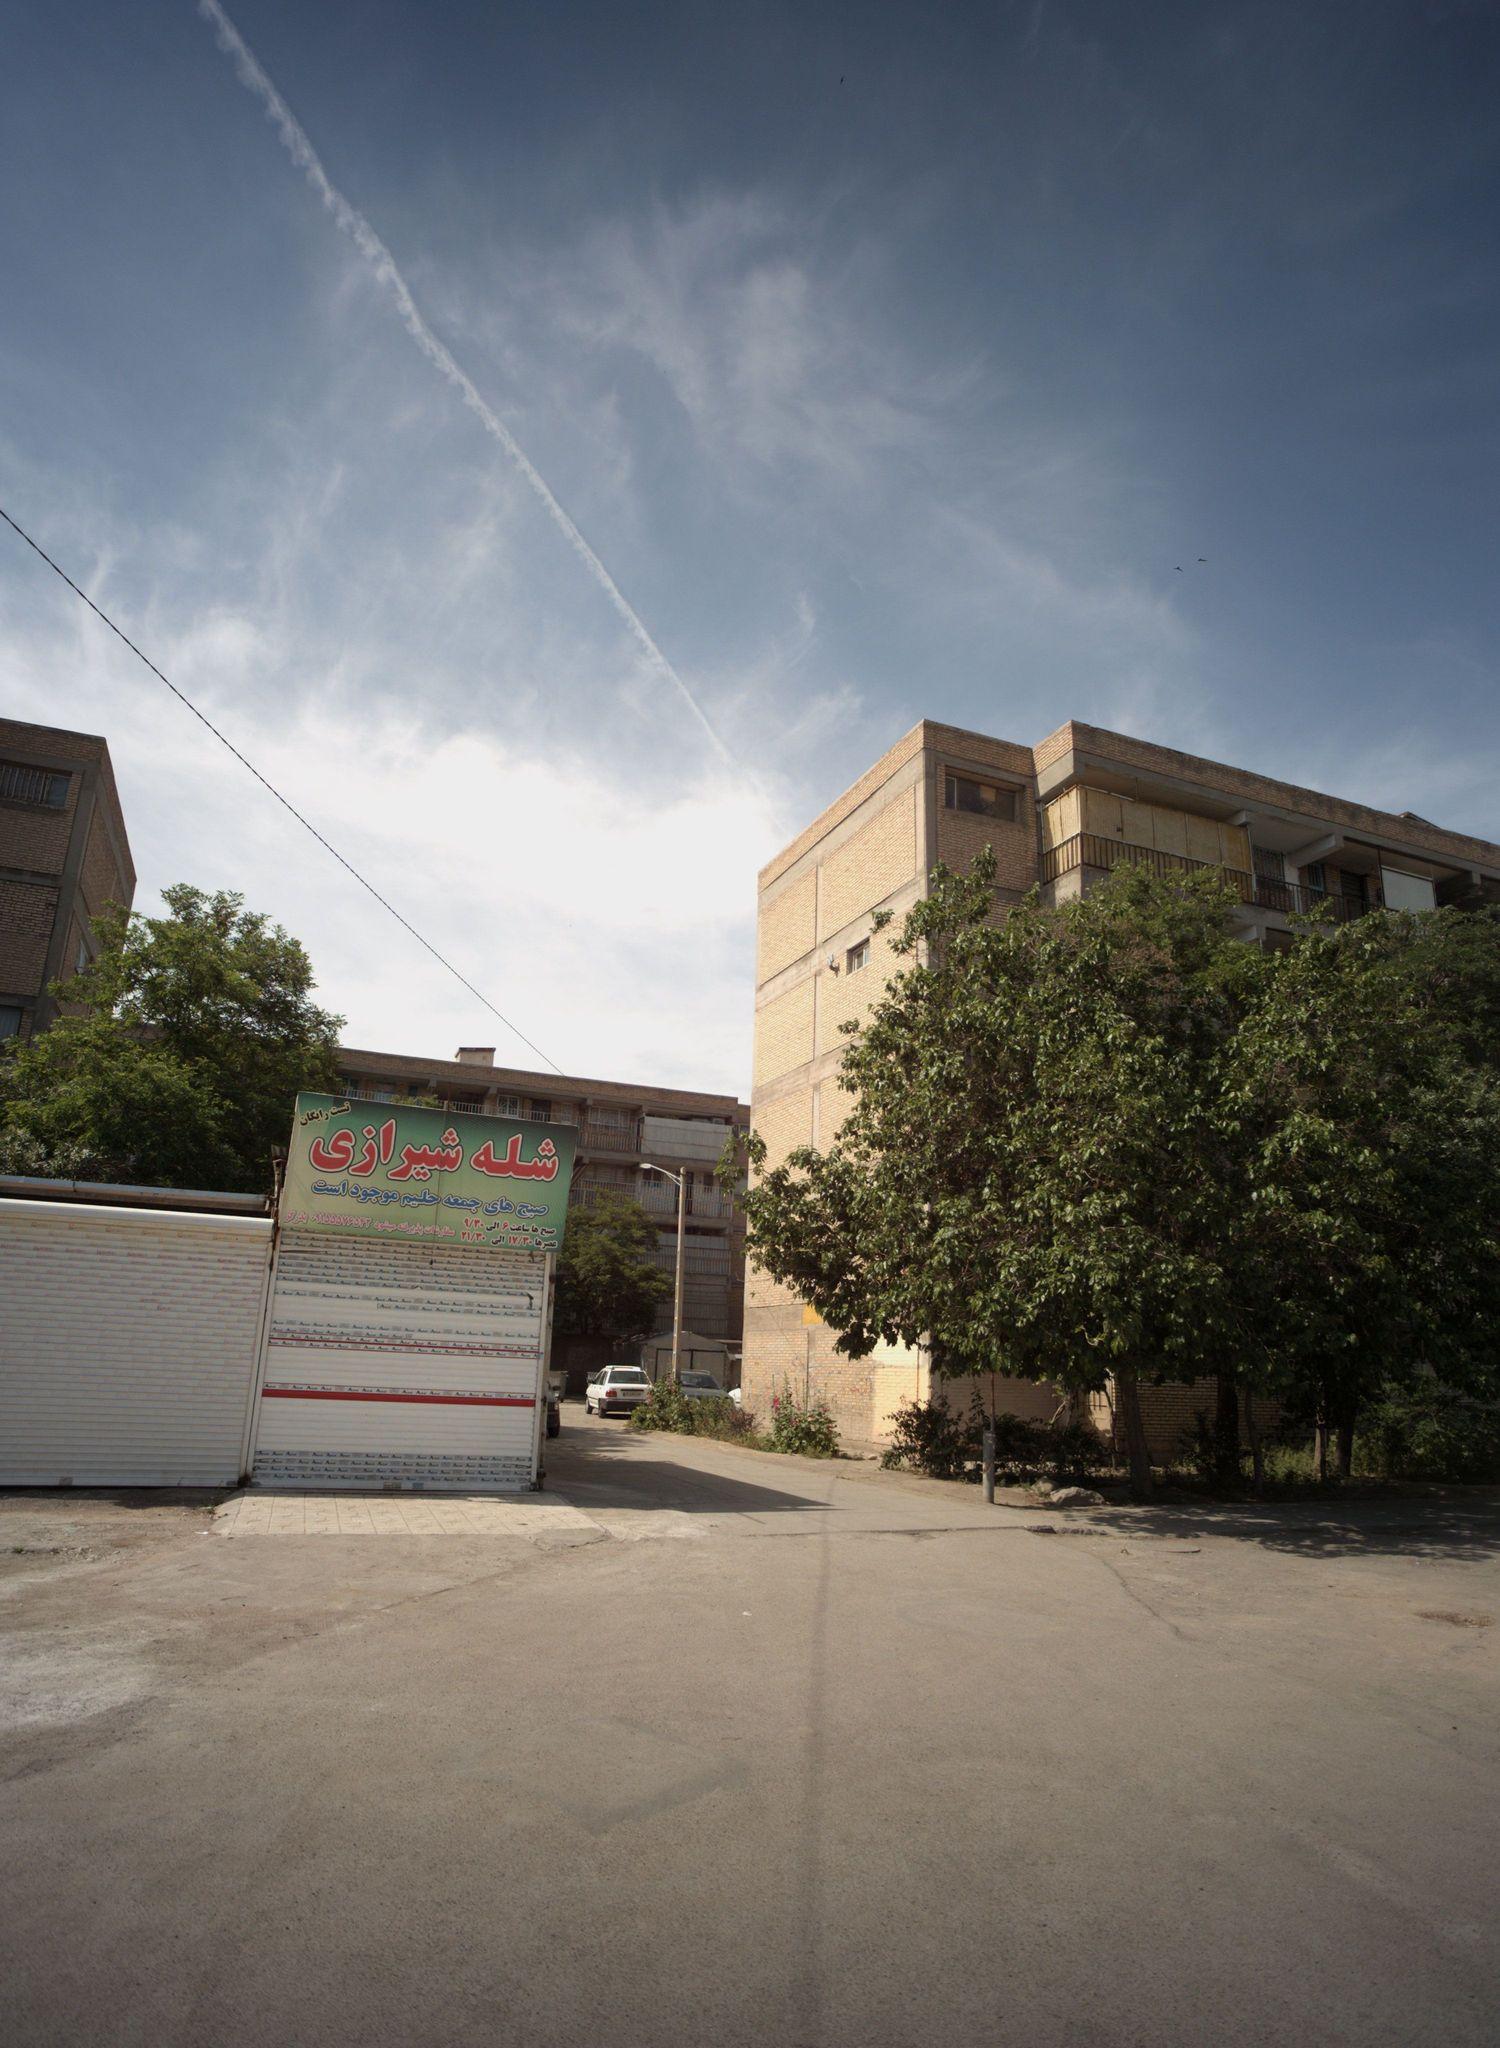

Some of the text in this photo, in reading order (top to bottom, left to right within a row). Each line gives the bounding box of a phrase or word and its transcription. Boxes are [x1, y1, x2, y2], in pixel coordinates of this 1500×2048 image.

[300, 1108, 330, 1126] رایگان
[309, 1117, 560, 1183] شله شیرازی
[311, 1178, 549, 1219] صبح های جمعه حلیم موجود است
[486, 1221, 500, 1232] الی
[510, 1223, 530, 1233] ساعت
[540, 1226, 556, 1237] صبح
[491, 1234, 505, 1246] الی
